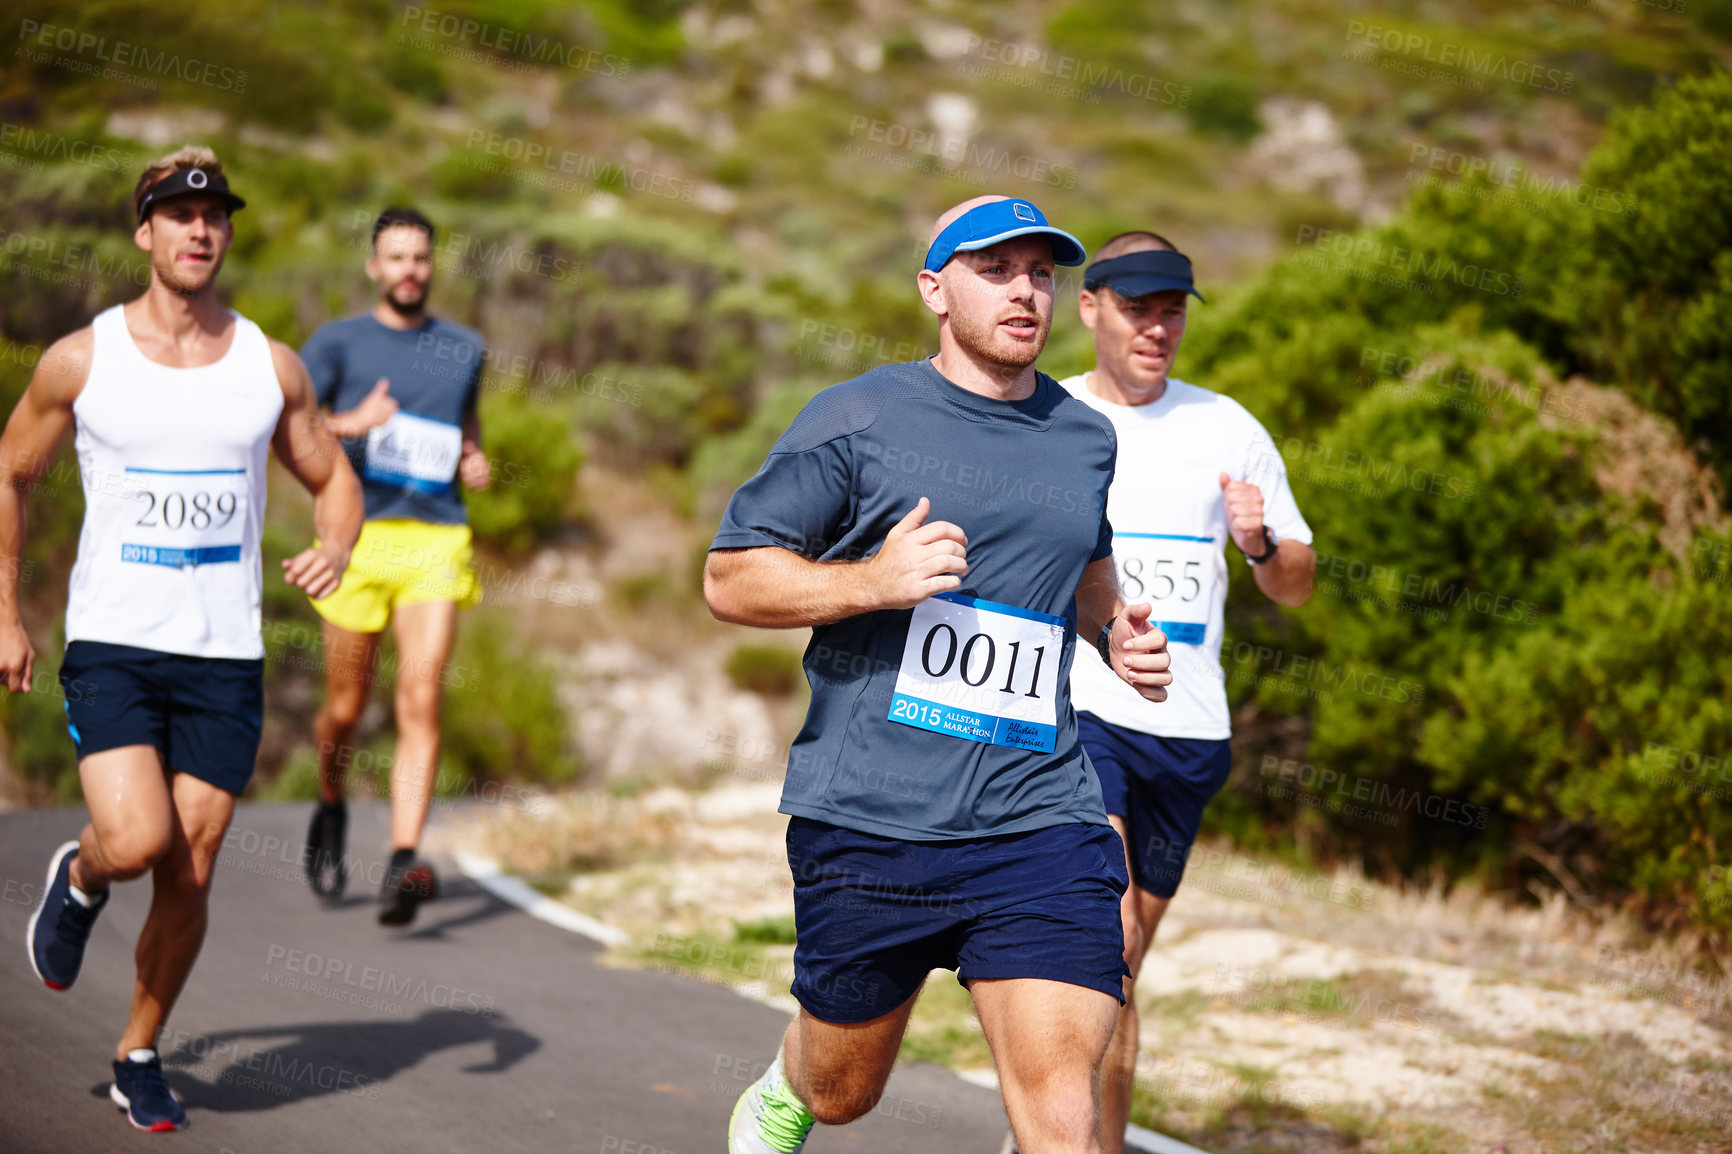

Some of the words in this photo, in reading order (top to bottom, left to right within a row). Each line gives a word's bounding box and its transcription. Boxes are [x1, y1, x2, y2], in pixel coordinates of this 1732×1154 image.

[136, 491, 236, 530] 2089
[1121, 557, 1200, 602] 855
[921, 623, 1045, 698] 0011
[893, 699, 942, 726] 2015
[945, 712, 980, 727] ALLSTAR
[943, 721, 991, 738] MARATHON
[1005, 732, 1045, 748] Enterprises
